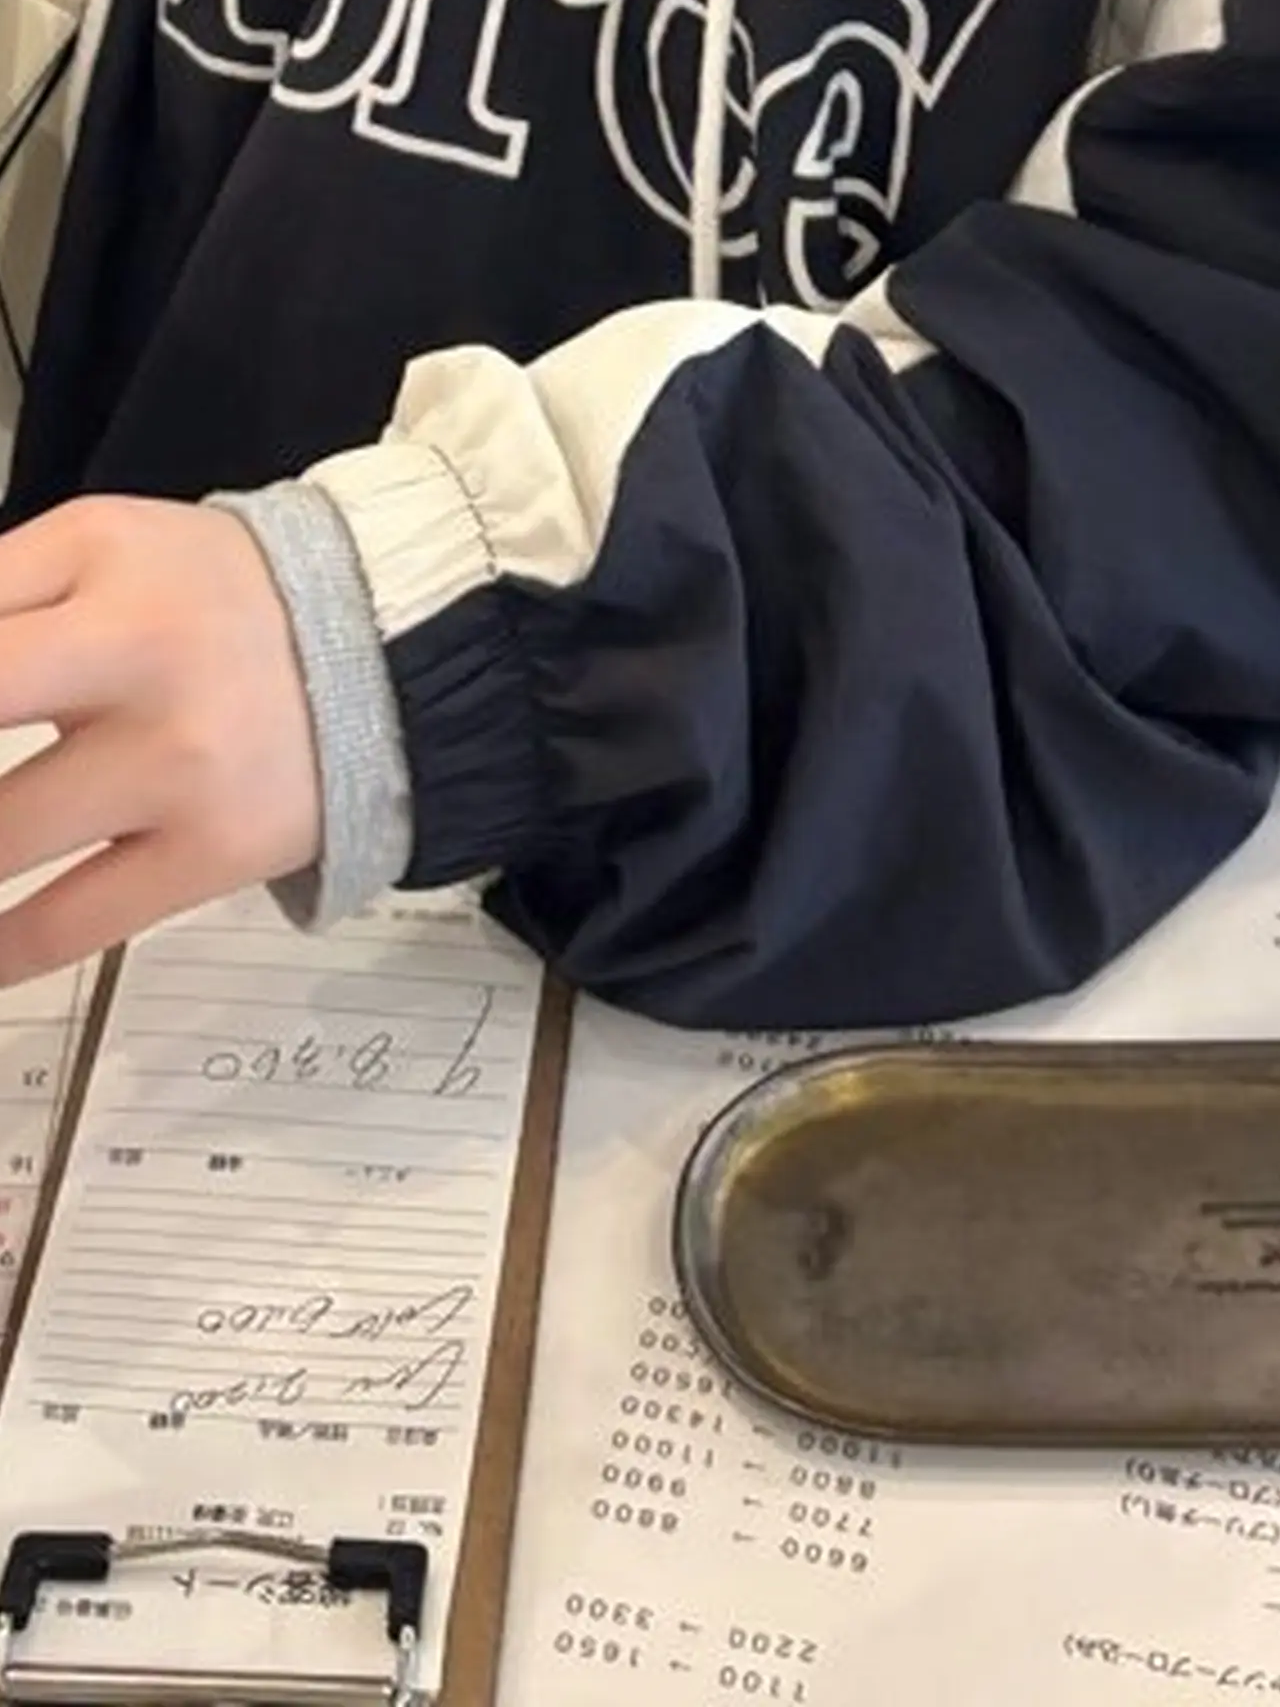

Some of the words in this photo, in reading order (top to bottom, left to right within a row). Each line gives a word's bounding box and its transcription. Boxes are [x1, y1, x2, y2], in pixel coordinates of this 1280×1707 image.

[780, 1537, 869, 1575] 6600
[565, 1593, 657, 1632] 3300
[726, 1627, 819, 1664] 2200
[718, 1664, 808, 1705] 1100
